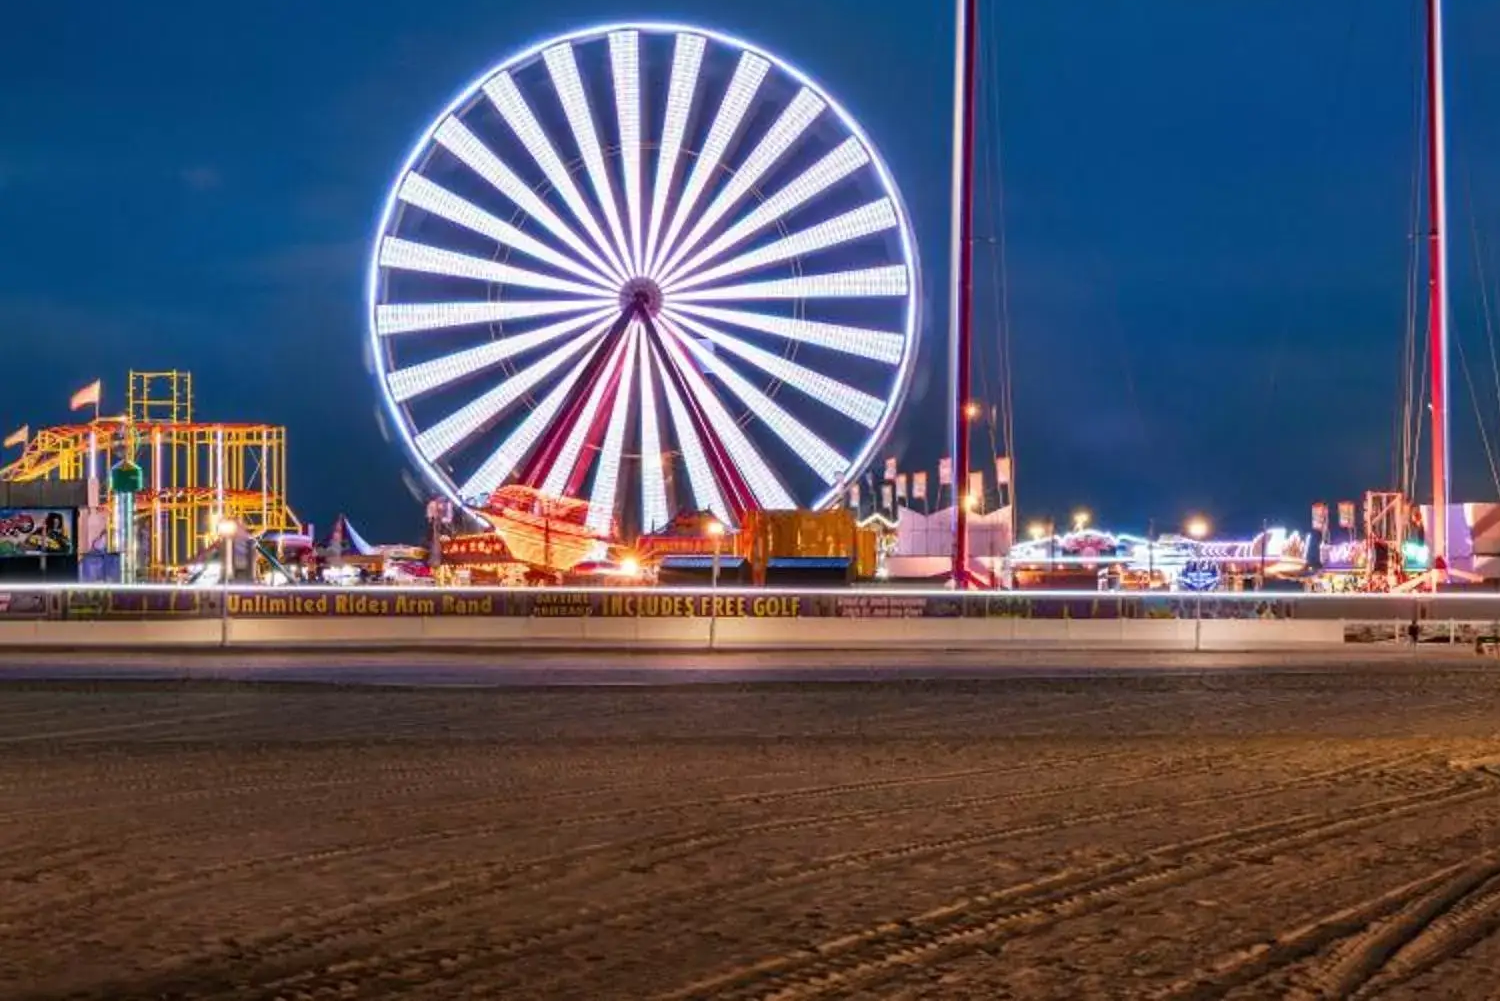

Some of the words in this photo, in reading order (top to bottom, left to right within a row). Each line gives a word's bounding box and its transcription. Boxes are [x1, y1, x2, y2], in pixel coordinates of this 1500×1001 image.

[227, 593, 327, 614] Unlimited
[335, 594, 388, 614] Rides
[395, 595, 435, 614] Arm
[442, 595, 492, 614] Band
[602, 595, 694, 616] INCLUDES
[700, 596, 746, 616] FREE
[752, 596, 801, 616] GOLF
